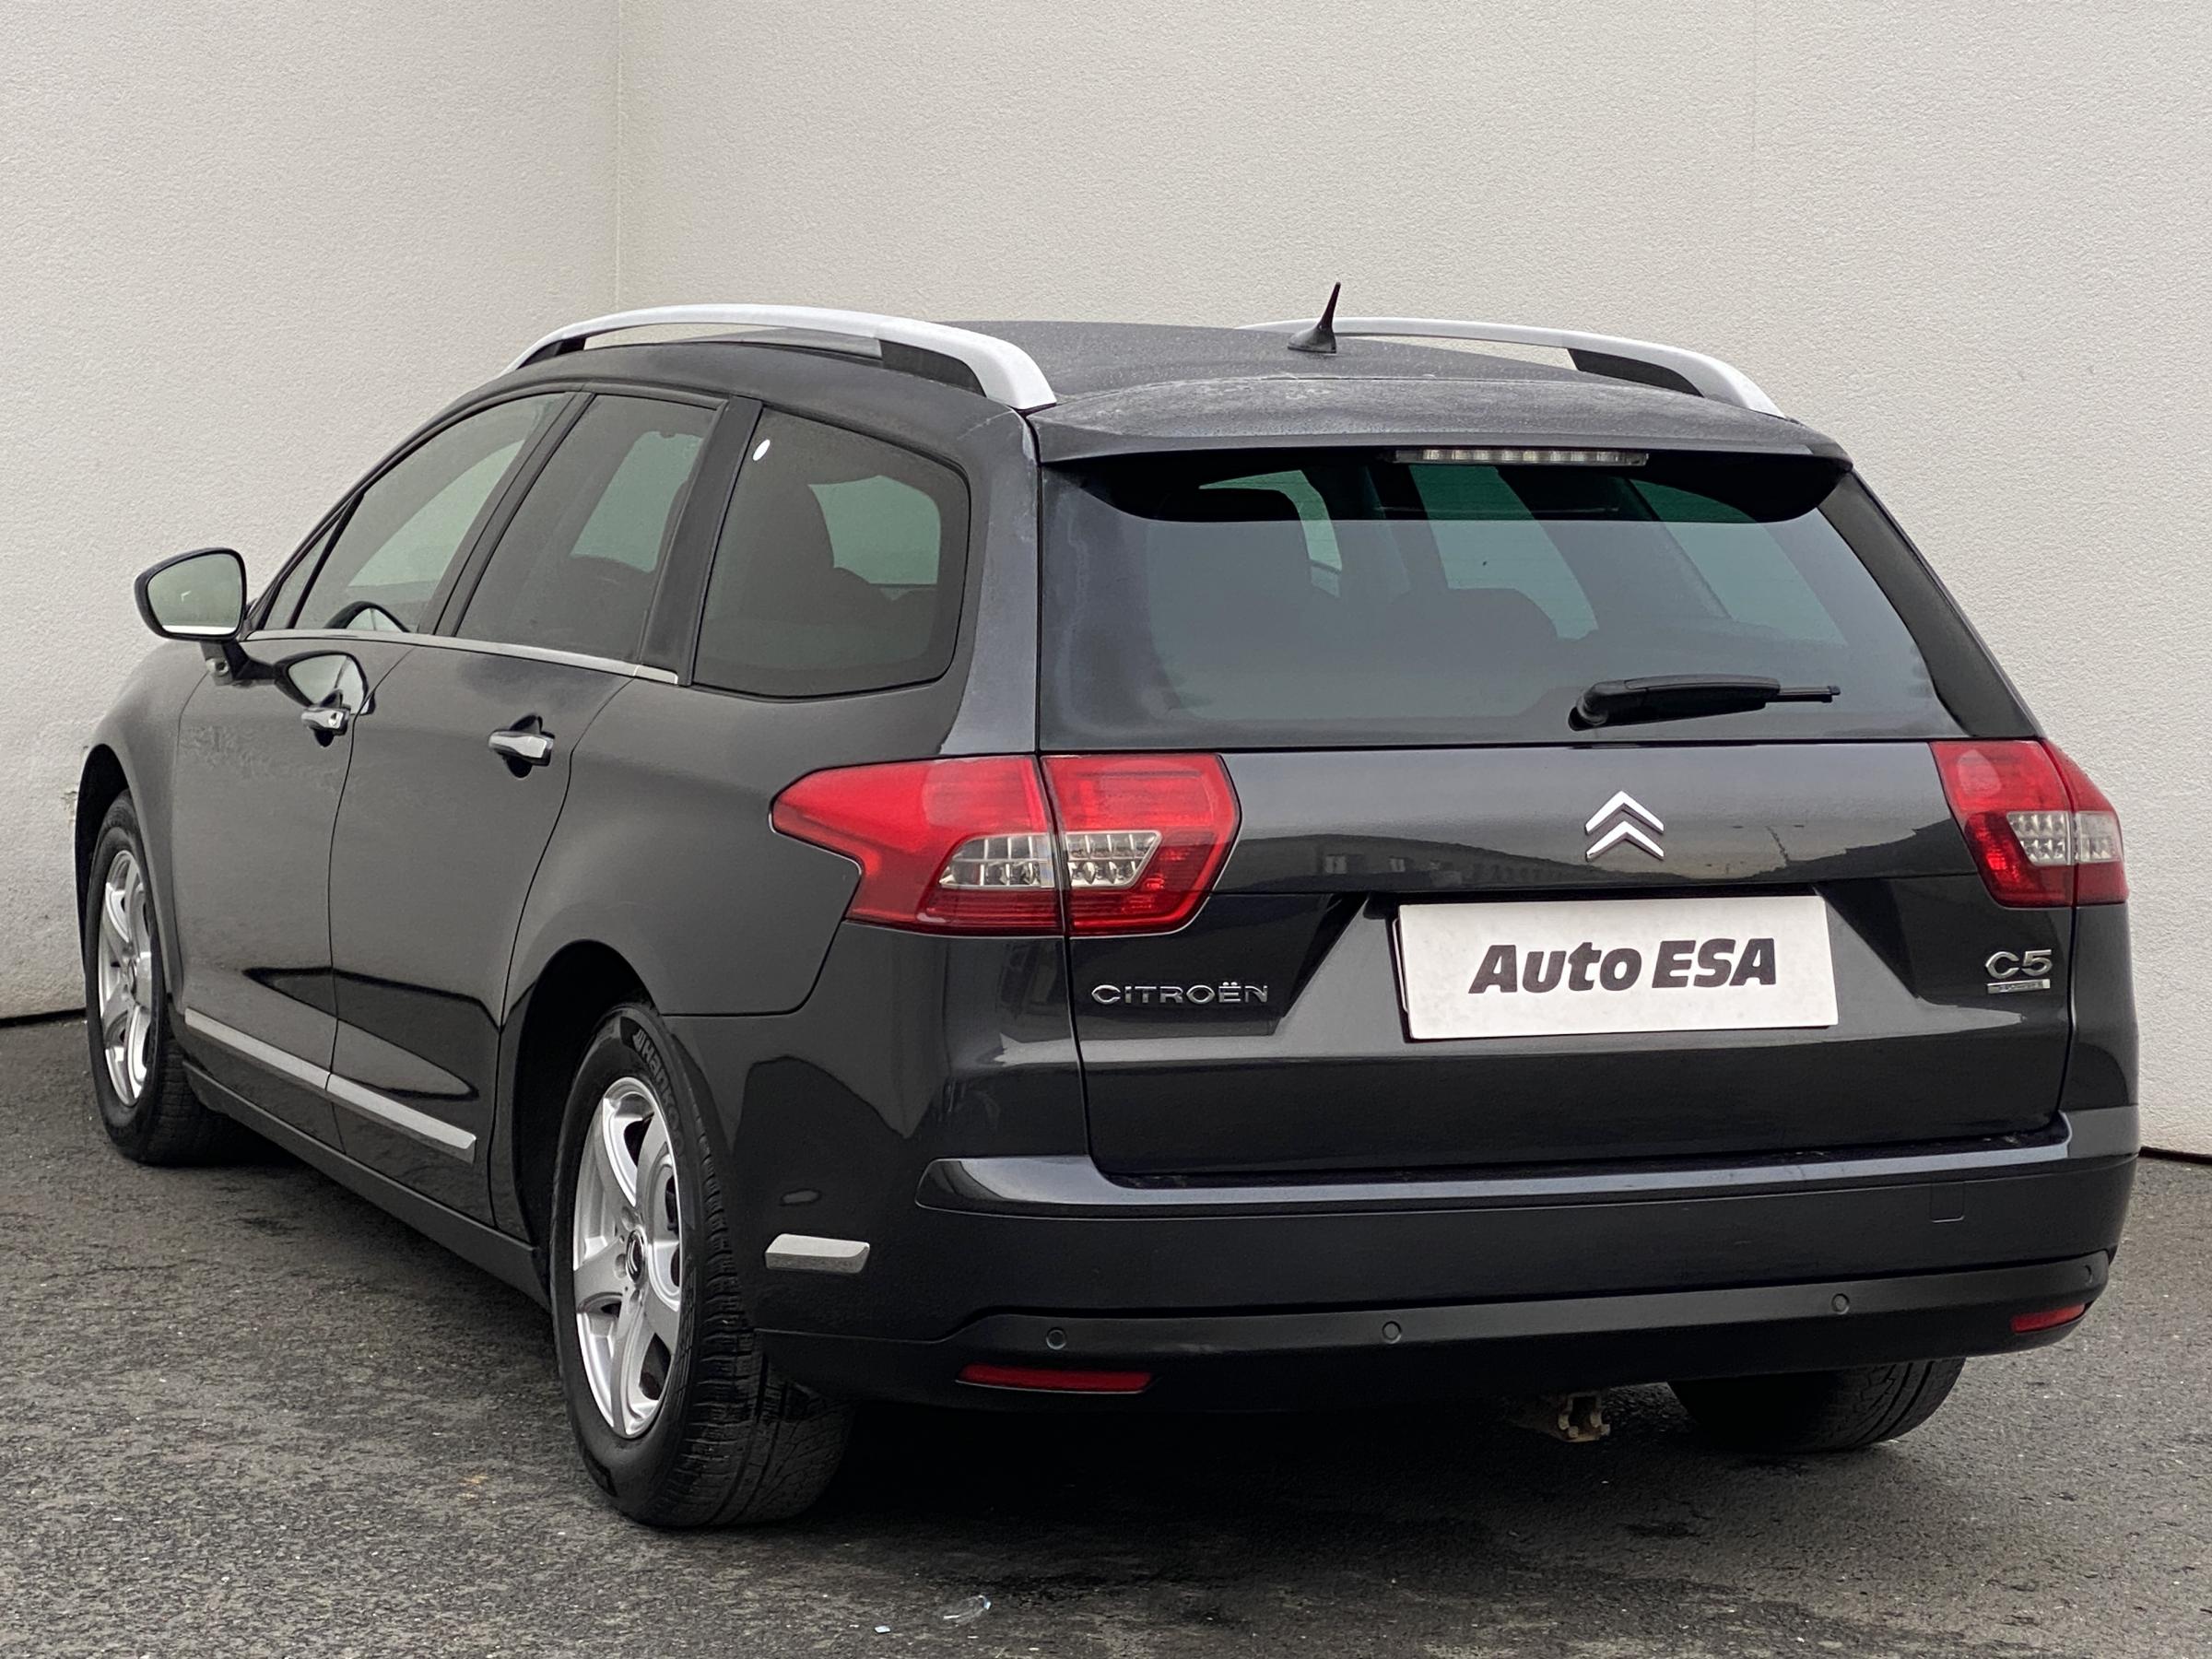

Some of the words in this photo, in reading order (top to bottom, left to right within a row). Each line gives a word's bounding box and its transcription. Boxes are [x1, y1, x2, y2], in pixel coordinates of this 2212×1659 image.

[1468, 942, 1642, 994] Auto
[1652, 938, 1776, 988] ESA
[1985, 948, 2053, 979] C5
[1091, 982, 1268, 1005] CITROËN
[641, 1038, 686, 1161] Hankoo
